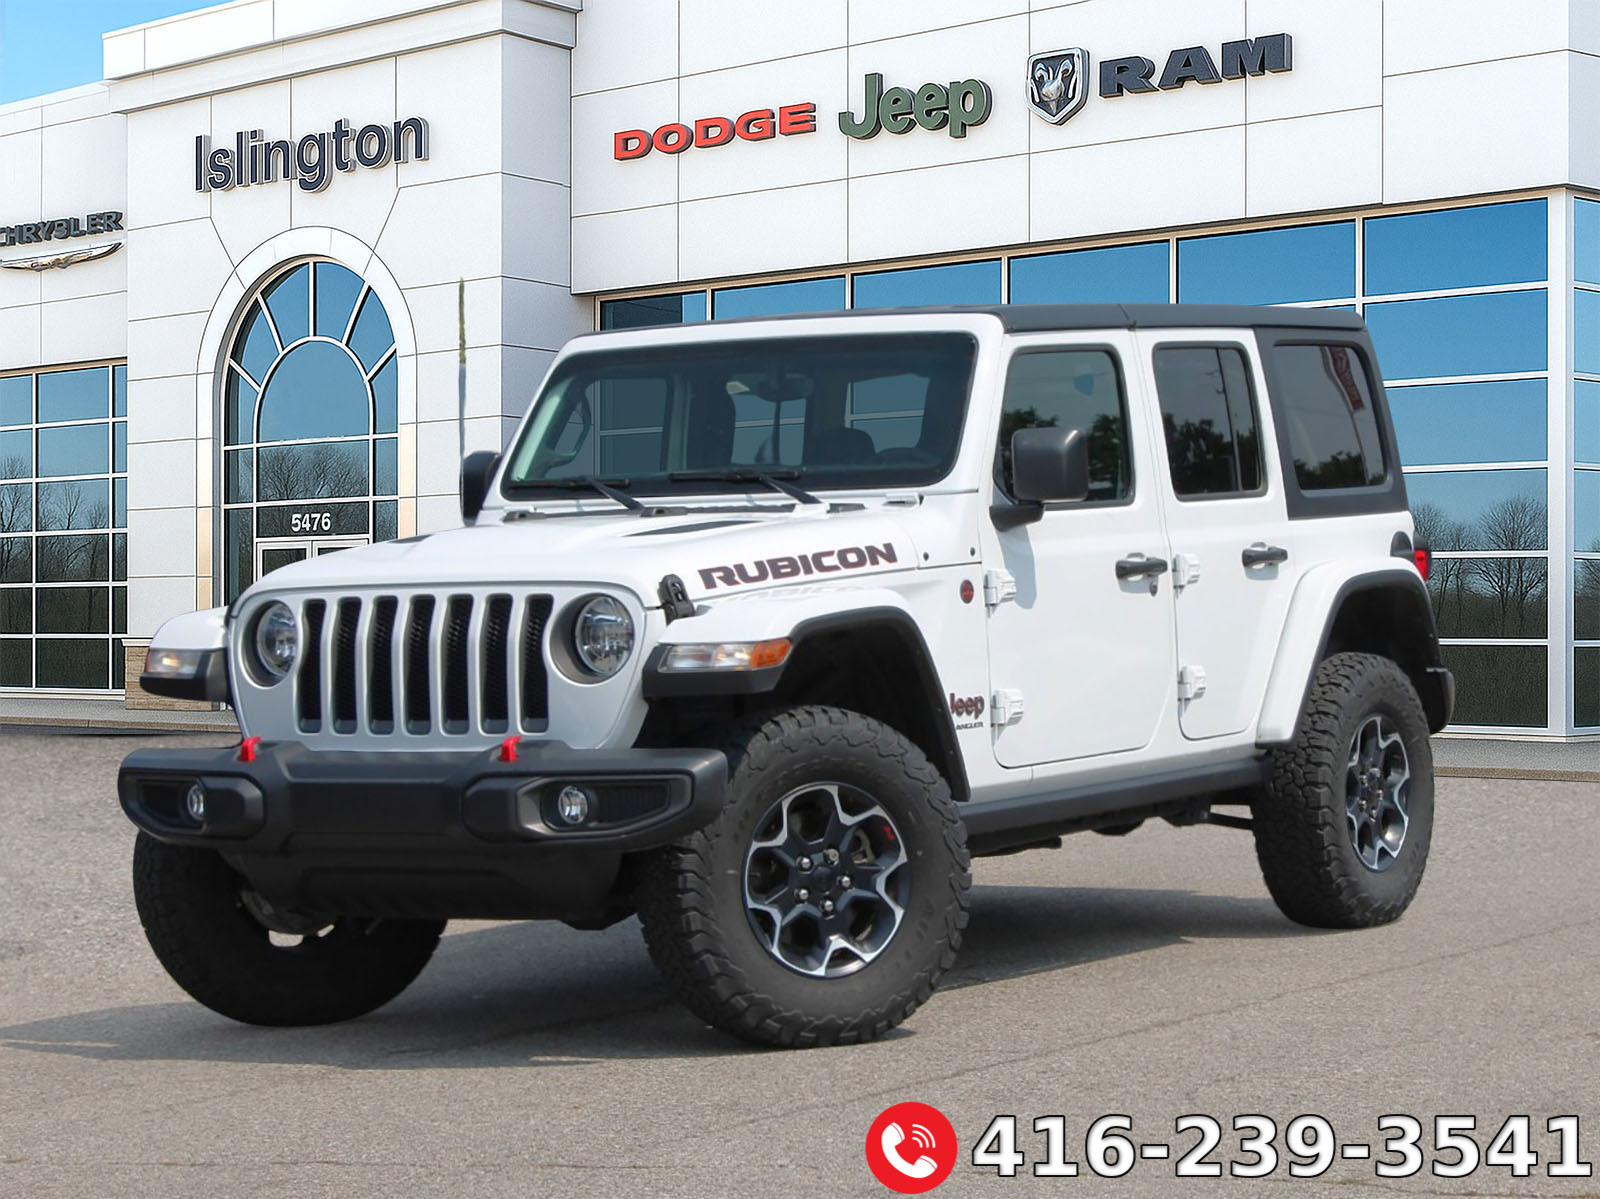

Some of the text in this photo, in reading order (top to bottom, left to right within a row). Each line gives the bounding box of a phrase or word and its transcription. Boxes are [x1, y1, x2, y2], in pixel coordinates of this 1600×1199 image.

[1099, 33, 1294, 99] RAM
[613, 101, 817, 161] DODGE
[838, 72, 993, 141] Jeep
[195, 116, 429, 193] Islington
[291, 512, 331, 532] 5476
[698, 542, 898, 590] RUBICON
